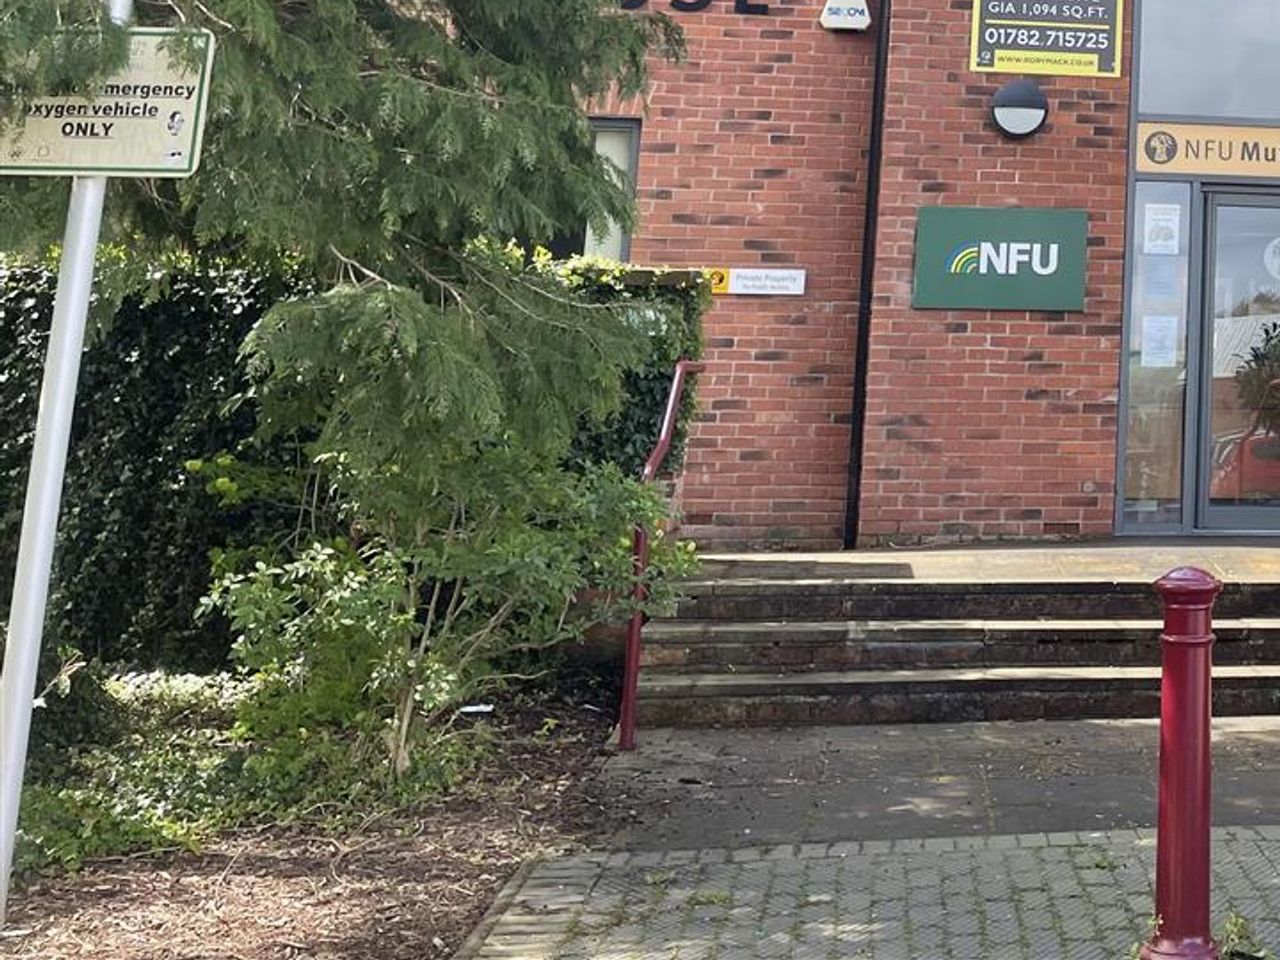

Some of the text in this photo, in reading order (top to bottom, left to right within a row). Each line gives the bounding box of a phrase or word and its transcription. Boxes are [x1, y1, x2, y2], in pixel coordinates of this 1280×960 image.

[988, 1, 1108, 19] GIA 1,094 SQ.FT.
[100, 83, 196, 100] mergency
[92, 102, 159, 117] vehicle
[61, 123, 114, 137] ONLY
[1185, 139, 1233, 161] NFU
[979, 241, 1059, 276] NFU
